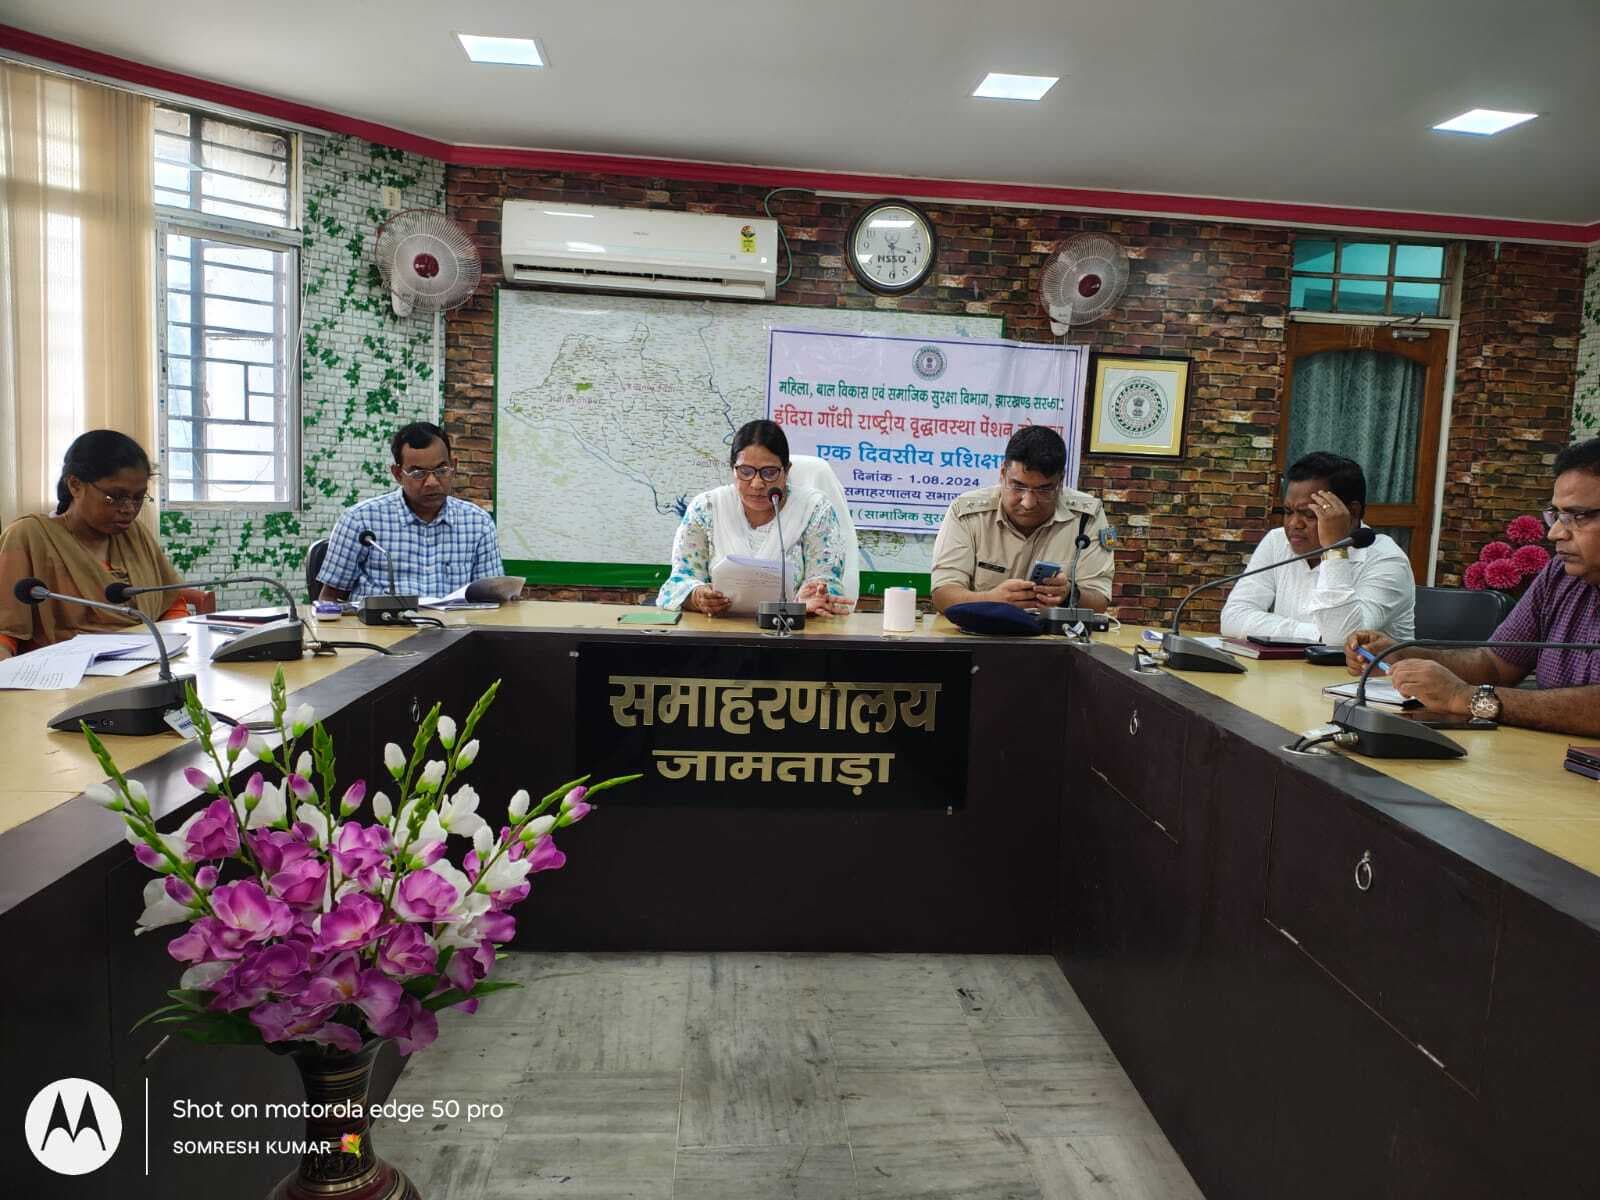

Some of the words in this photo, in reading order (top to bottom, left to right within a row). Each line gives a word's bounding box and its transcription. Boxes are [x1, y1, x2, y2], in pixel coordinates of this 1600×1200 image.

[778, 377, 813, 398] महिला,
[816, 383, 835, 398] बाल
[838, 380, 868, 400] विकास
[872, 383, 884, 400] एवं
[932, 390, 957, 408] सुरक्षा
[960, 388, 992, 408] विभाग,
[774, 404, 812, 426] इंदिरा
[818, 405, 852, 429] गाँधी
[858, 410, 906, 434] राष्ट्रीय
[910, 417, 976, 438] वृद्धावस्था
[816, 444, 851, 461] एक
[858, 441, 933, 466] दिवसीय
[940, 446, 1006, 470] प्रशिक्ष
[853, 469, 892, 483] दिनांक
[910, 474, 980, 487] 1.08.2024
[844, 487, 922, 500] समाहरणालय
[923, 513, 945, 526] सुर
[608, 675, 942, 734] समाहरणालय
[652, 749, 896, 796] जामताड़ा
